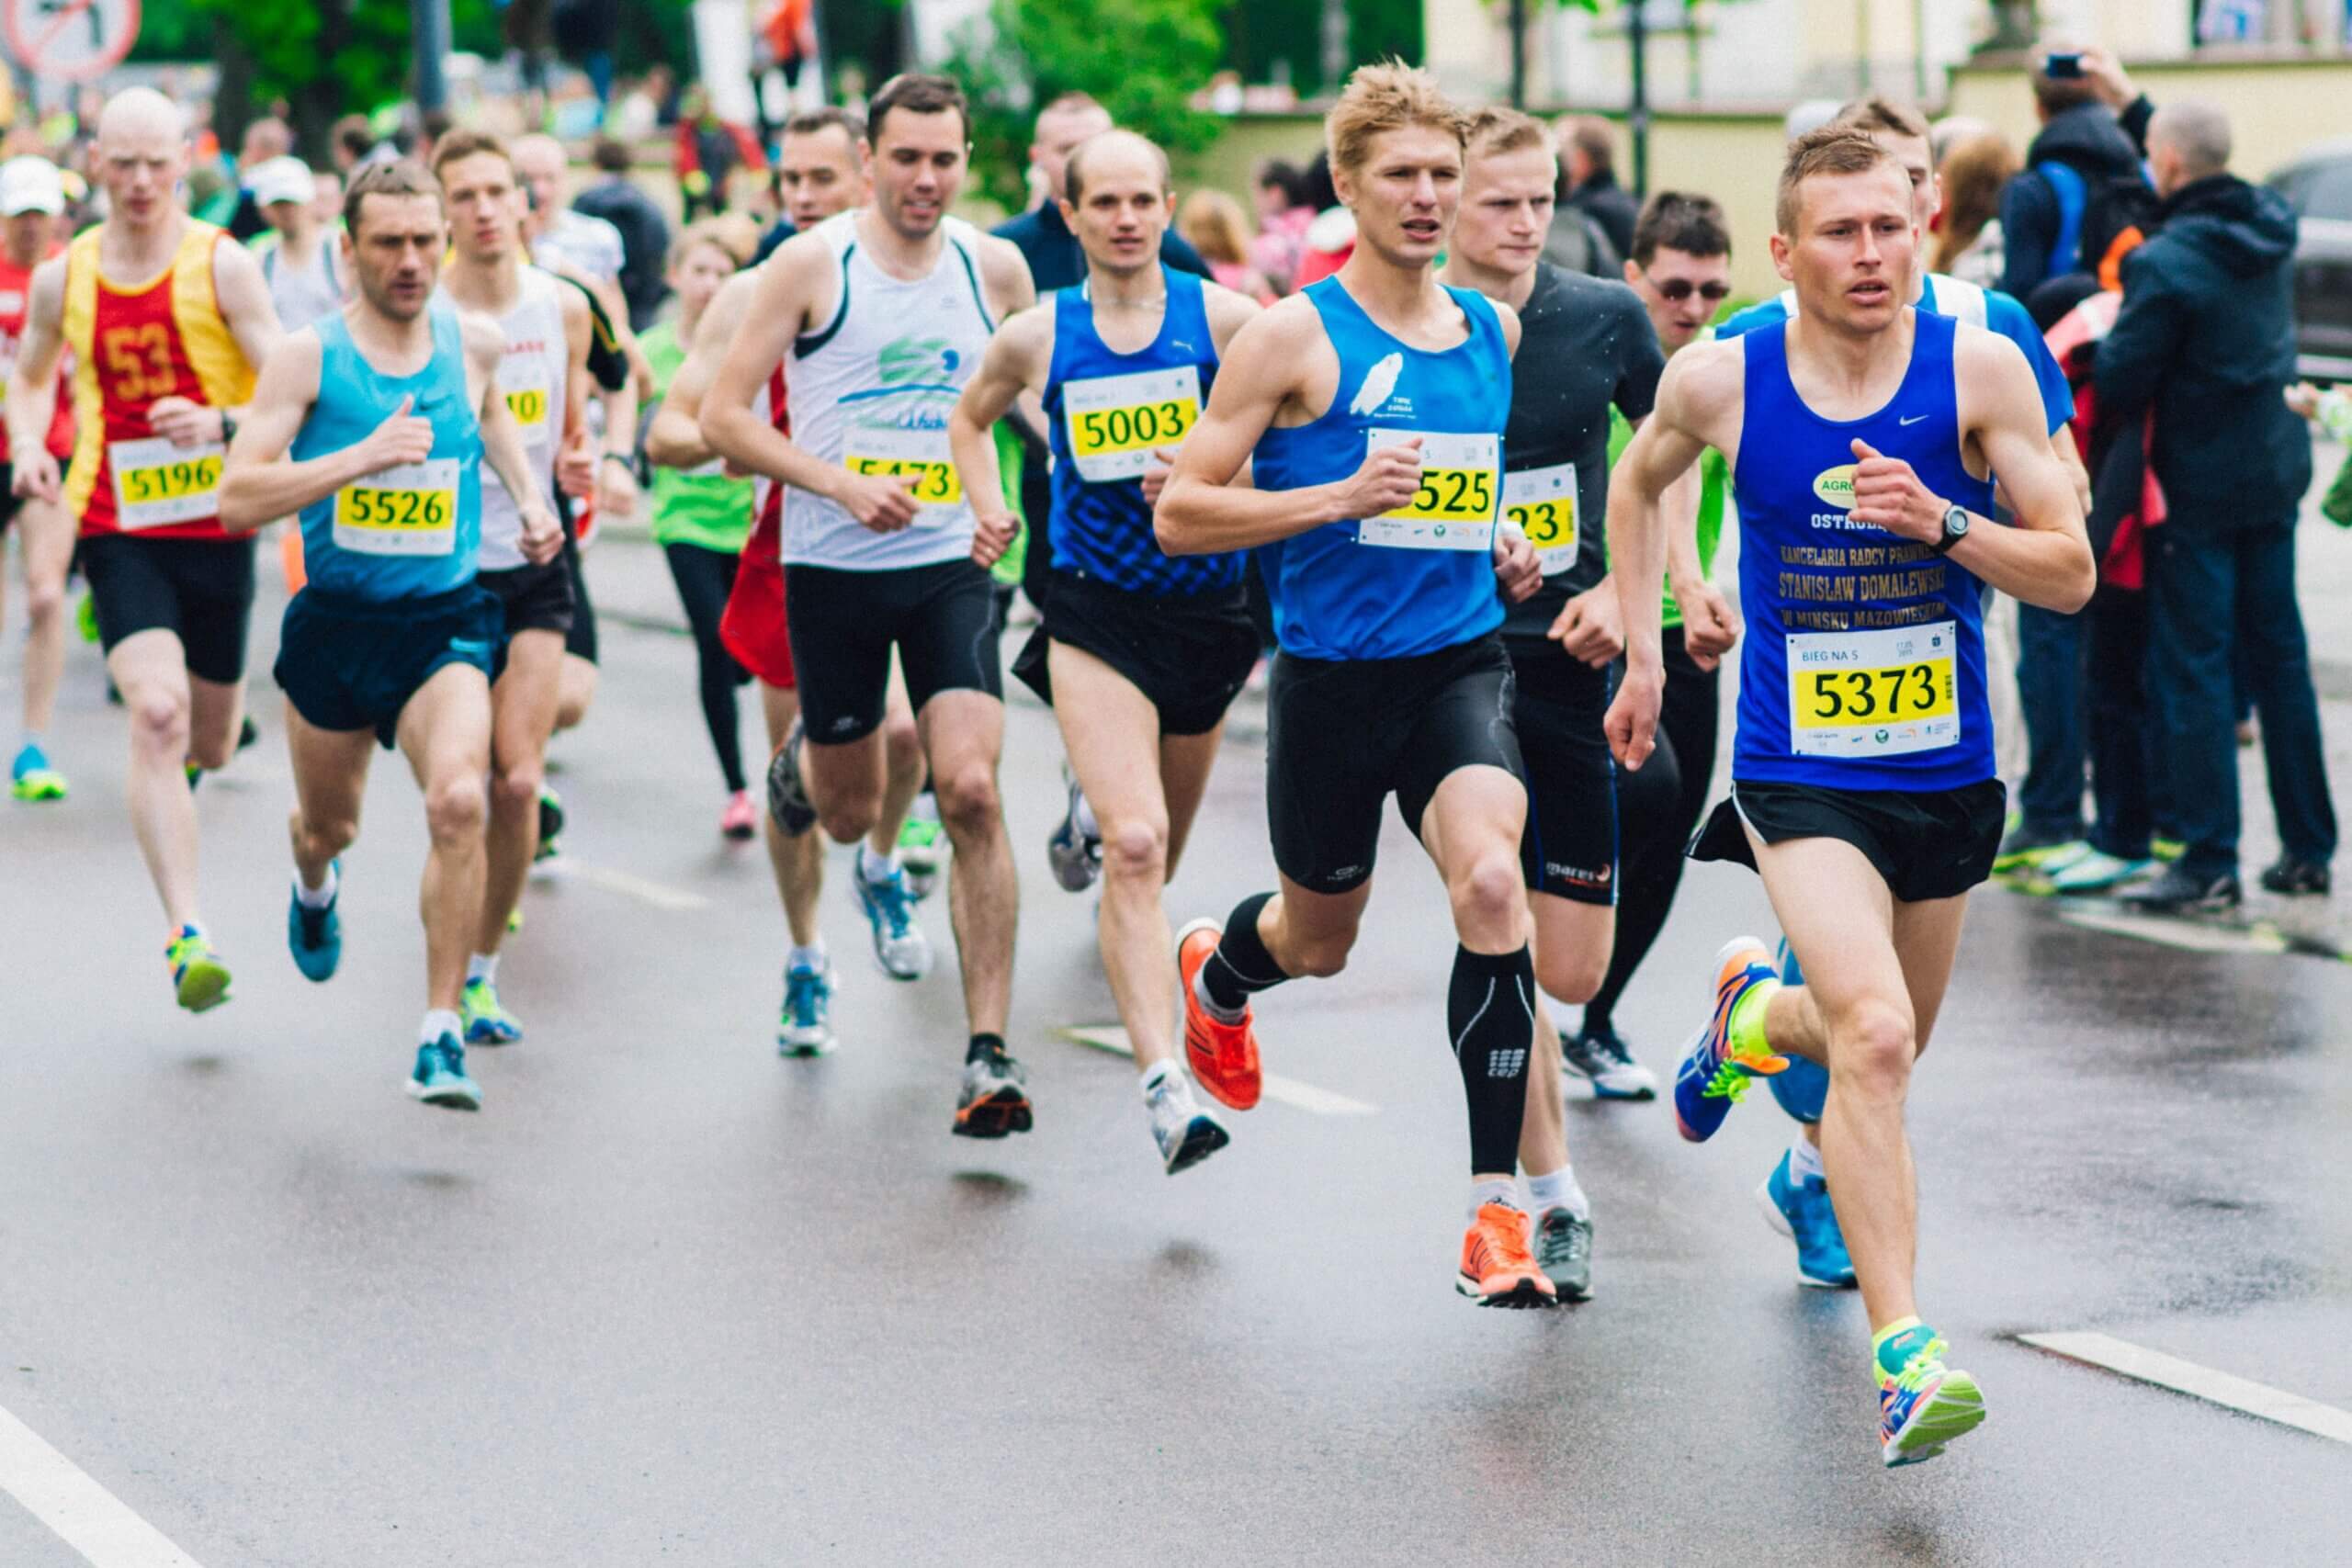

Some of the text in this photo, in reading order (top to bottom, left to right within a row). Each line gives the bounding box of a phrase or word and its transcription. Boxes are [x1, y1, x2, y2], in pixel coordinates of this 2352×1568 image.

[104, 323, 177, 399] 53
[1085, 403, 1184, 447] 5003
[131, 458, 215, 497] 5196
[351, 489, 443, 525] 5526
[1849, 547, 1885, 566] RADCY
[1779, 571, 1856, 602] STANISŁAW
[1802, 650, 1859, 662] BIEG NA 5
[1815, 664, 1936, 718] 5373
